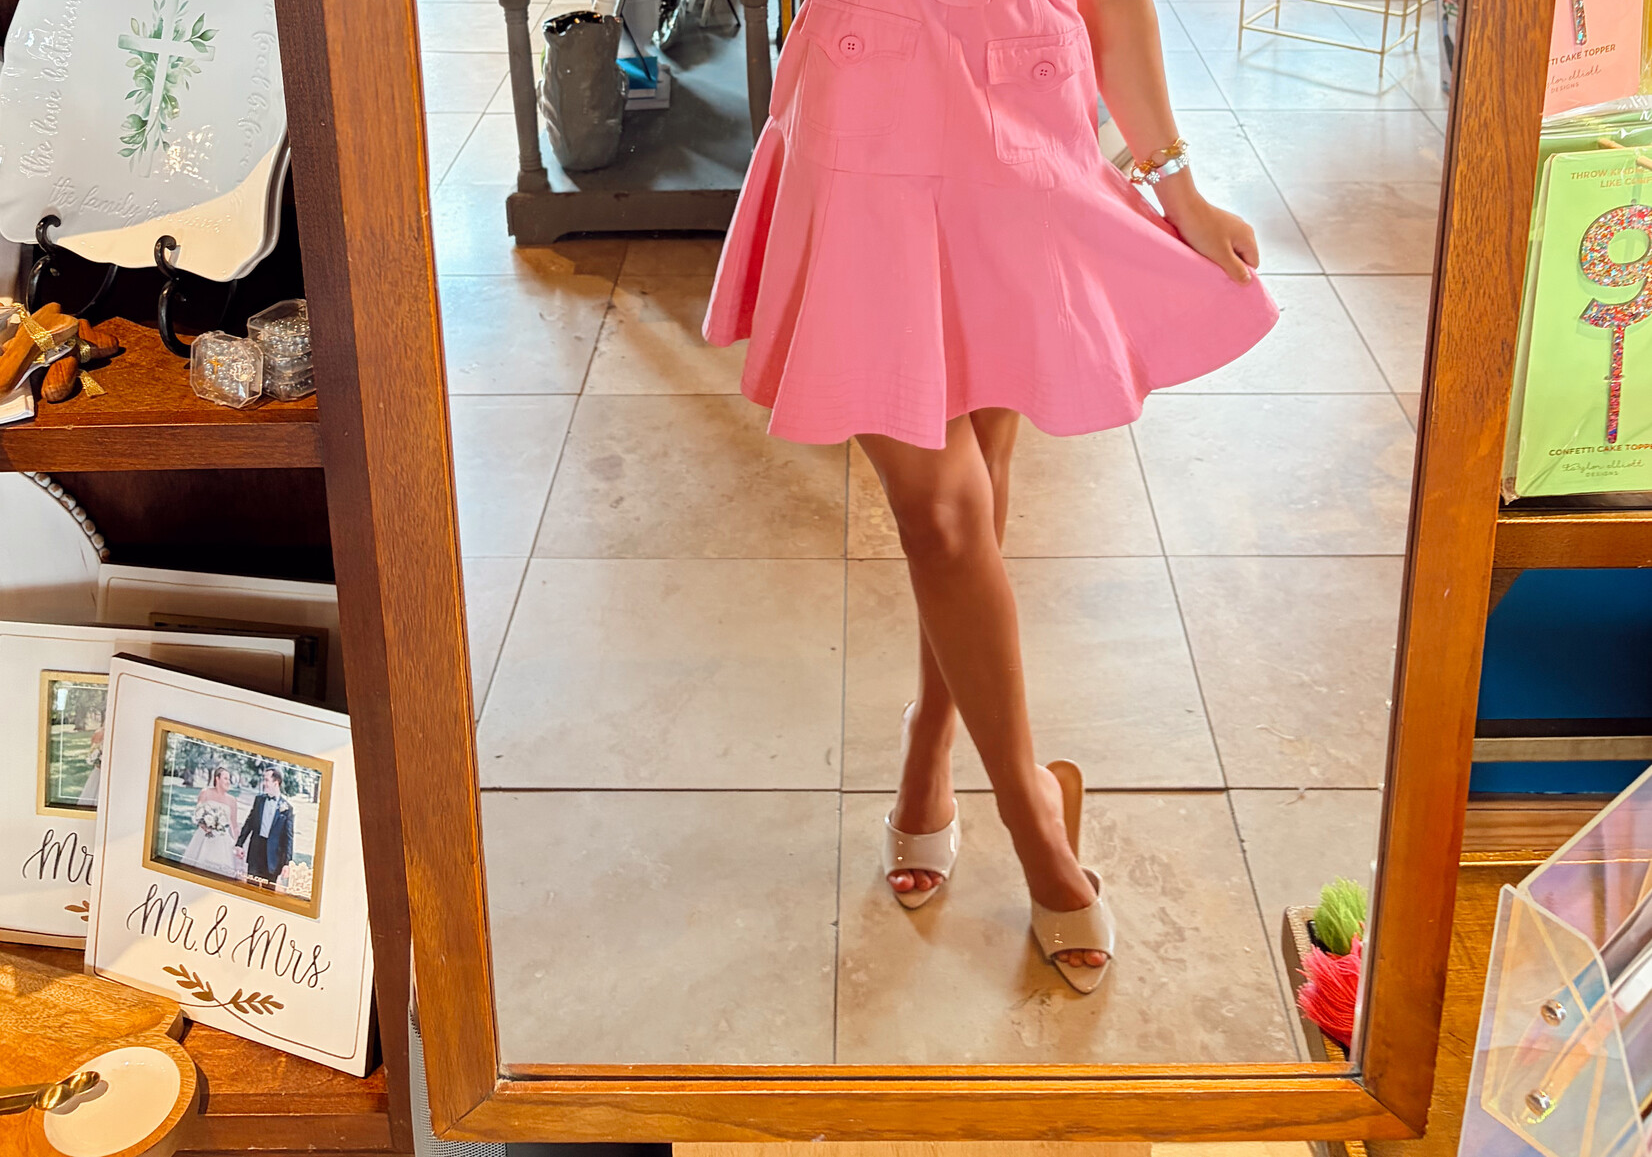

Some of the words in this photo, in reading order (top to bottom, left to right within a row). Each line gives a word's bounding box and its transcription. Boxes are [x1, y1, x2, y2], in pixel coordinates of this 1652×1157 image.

[1560, 51, 1582, 64] CAKE
[1584, 44, 1616, 57] TOPPER
[1550, 82, 1580, 94] DESIGNS
[1570, 169, 1608, 180] THROW
[1600, 180, 1622, 188] LIKE
[79, 185, 144, 228] family
[1548, 447, 1594, 456] CONFETTI
[1597, 444, 1622, 452] CAKE
[126, 884, 198, 952] Mr.
[204, 905, 228, 958] &
[231, 915, 331, 990] Mrs.
